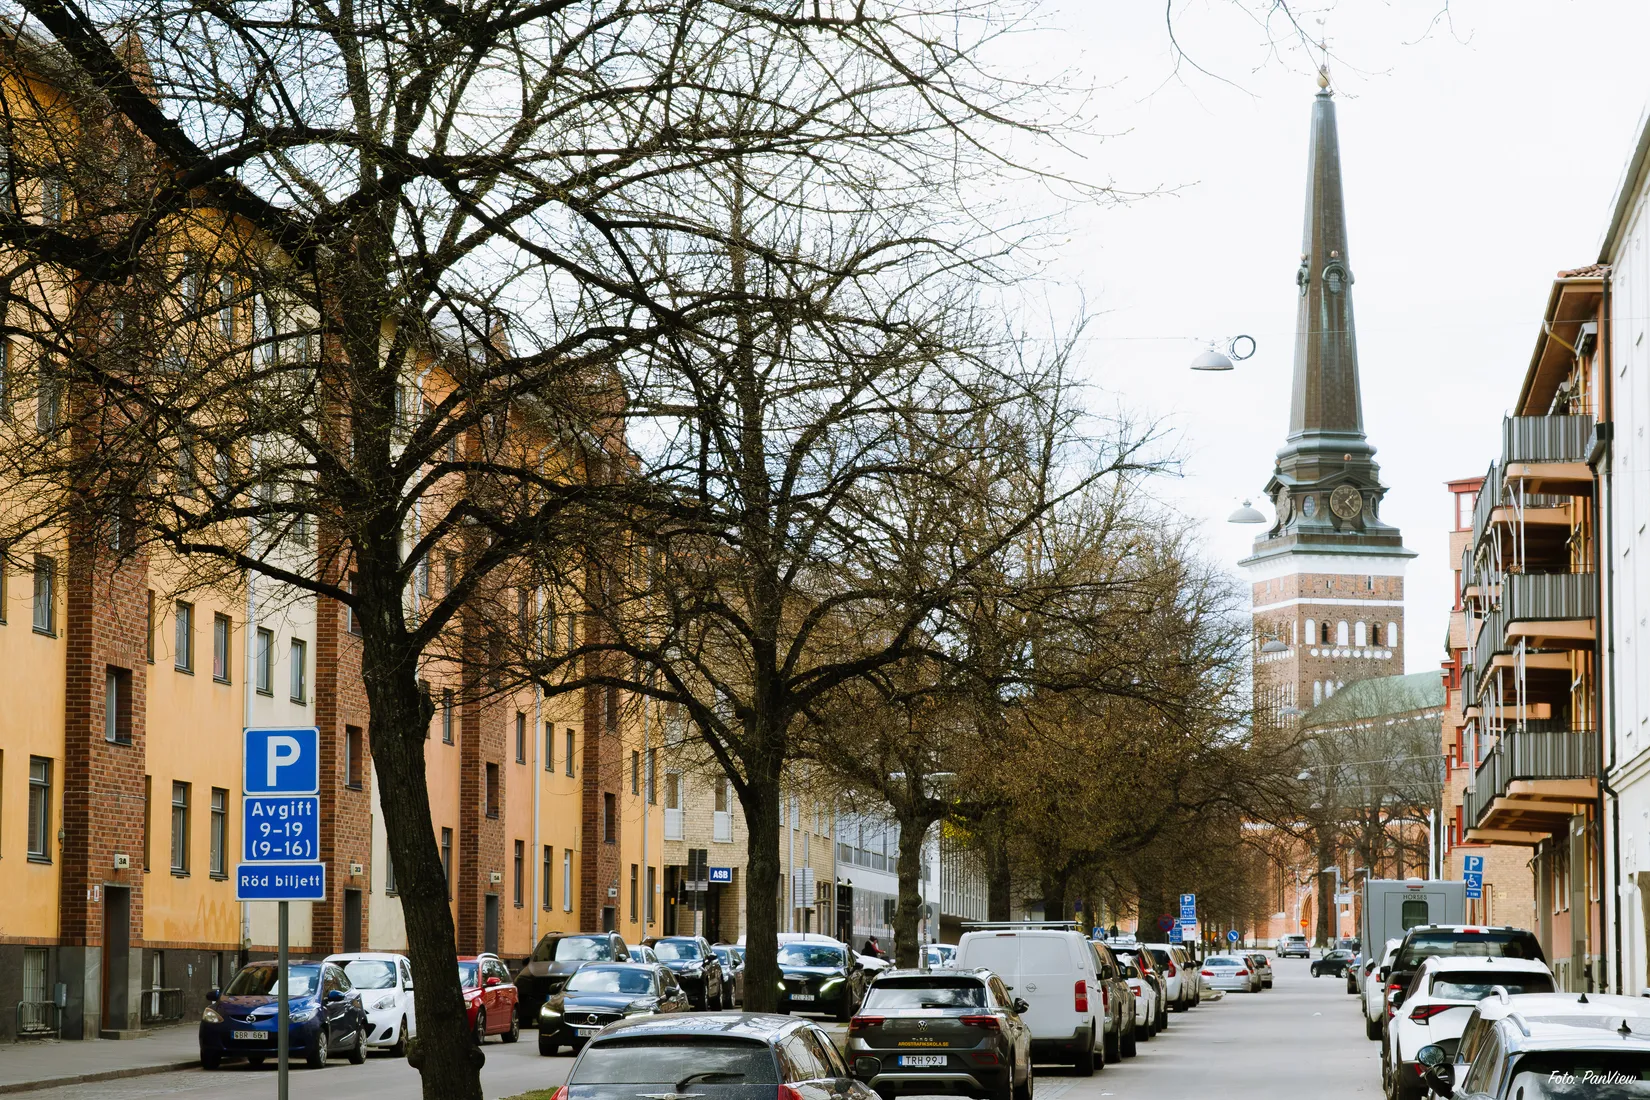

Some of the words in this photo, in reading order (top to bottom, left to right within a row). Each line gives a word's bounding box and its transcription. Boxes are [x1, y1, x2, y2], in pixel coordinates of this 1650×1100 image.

[267, 735, 301, 787] P
[251, 801, 312, 820] Avgift
[260, 822, 303, 837] 9-19
[251, 840, 311, 857] (9-16)
[118, 857, 127, 865] 3A
[1469, 857, 1480, 871] P
[713, 870, 729, 879] ASB
[241, 875, 269, 887] Röd
[275, 875, 320, 889] biljett
[905, 1056, 924, 1065] TRH
[925, 1056, 944, 1065] 99J
